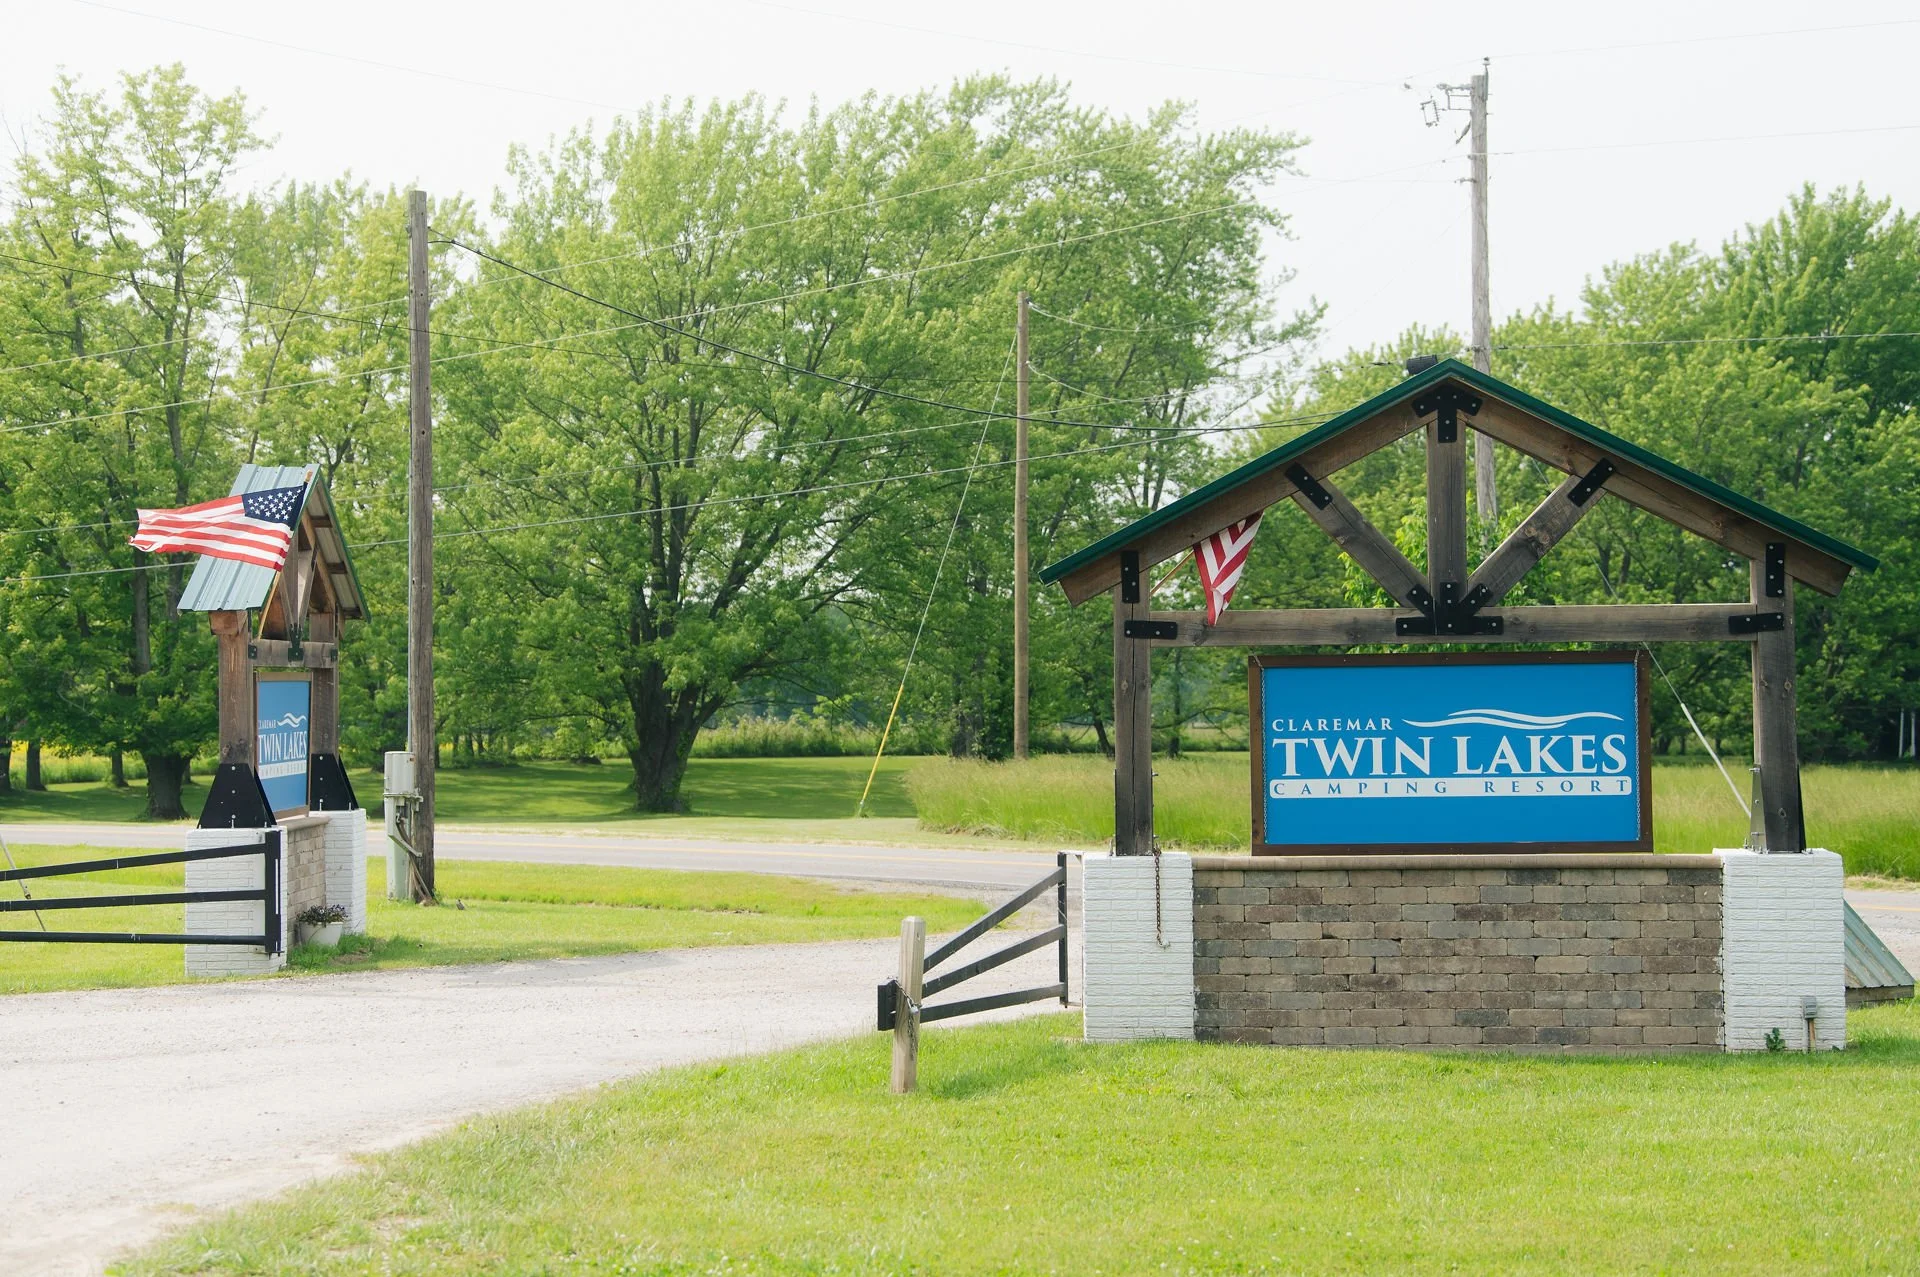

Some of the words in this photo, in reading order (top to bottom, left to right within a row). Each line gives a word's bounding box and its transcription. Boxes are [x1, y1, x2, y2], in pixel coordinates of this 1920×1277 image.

[1272, 717, 1393, 732] CLAREMAR
[257, 733, 282, 763] TWIN
[283, 731, 307, 760] LAKES
[1272, 736, 1433, 777] TWIN
[1452, 734, 1627, 775] LAKES
[1273, 779, 1447, 796] CAMPING
[1484, 778, 1630, 794] RESORT
